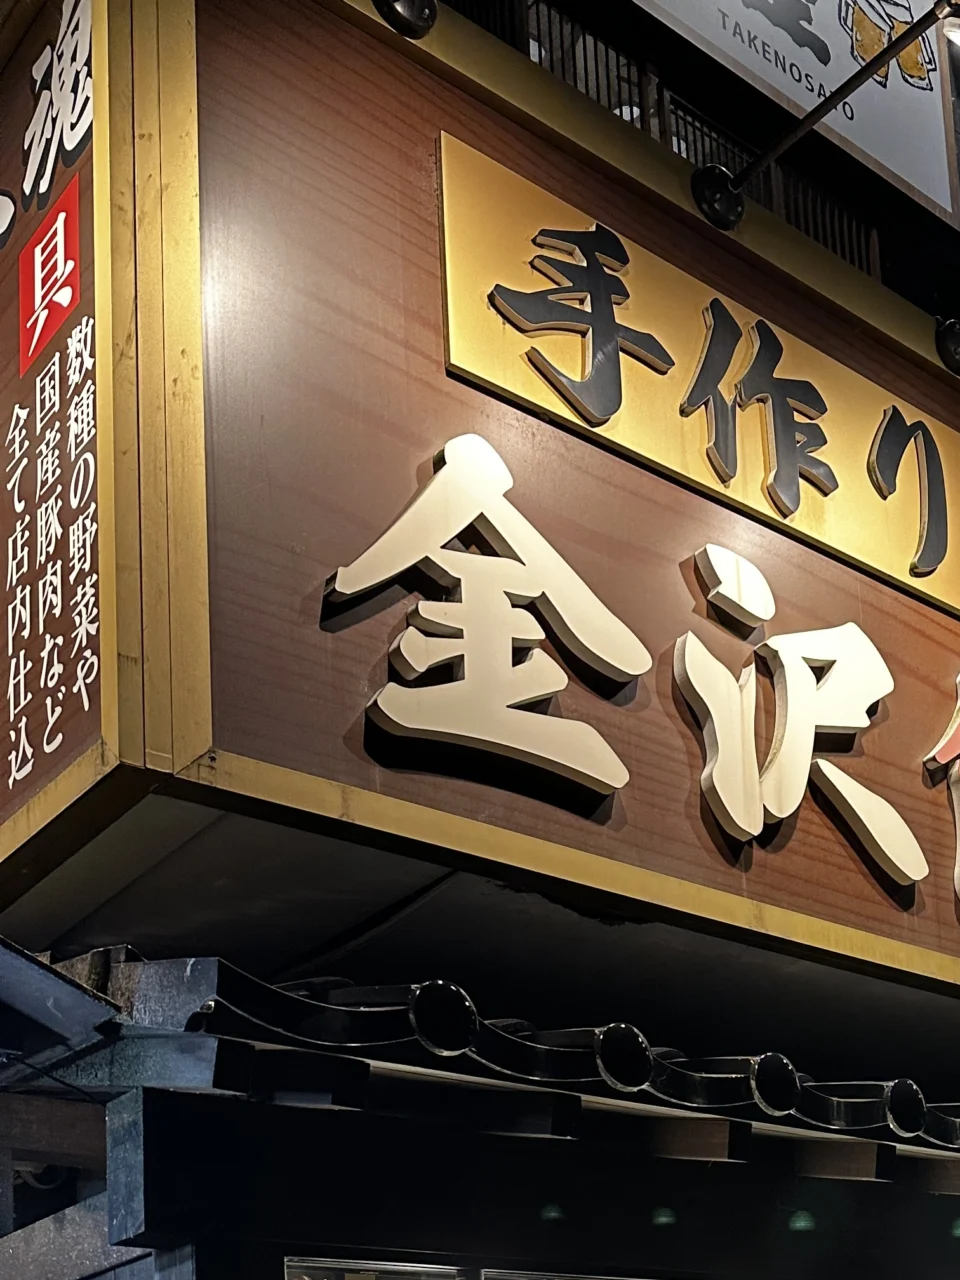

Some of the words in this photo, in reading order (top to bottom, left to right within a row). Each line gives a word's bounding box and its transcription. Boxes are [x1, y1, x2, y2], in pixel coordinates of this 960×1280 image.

[27, 210, 74, 352] 具
[4, 403, 34, 790] 全て店内仕込
[34, 352, 65, 754] 国産豚肉など
[66, 316, 99, 711] 数種の野菜や
